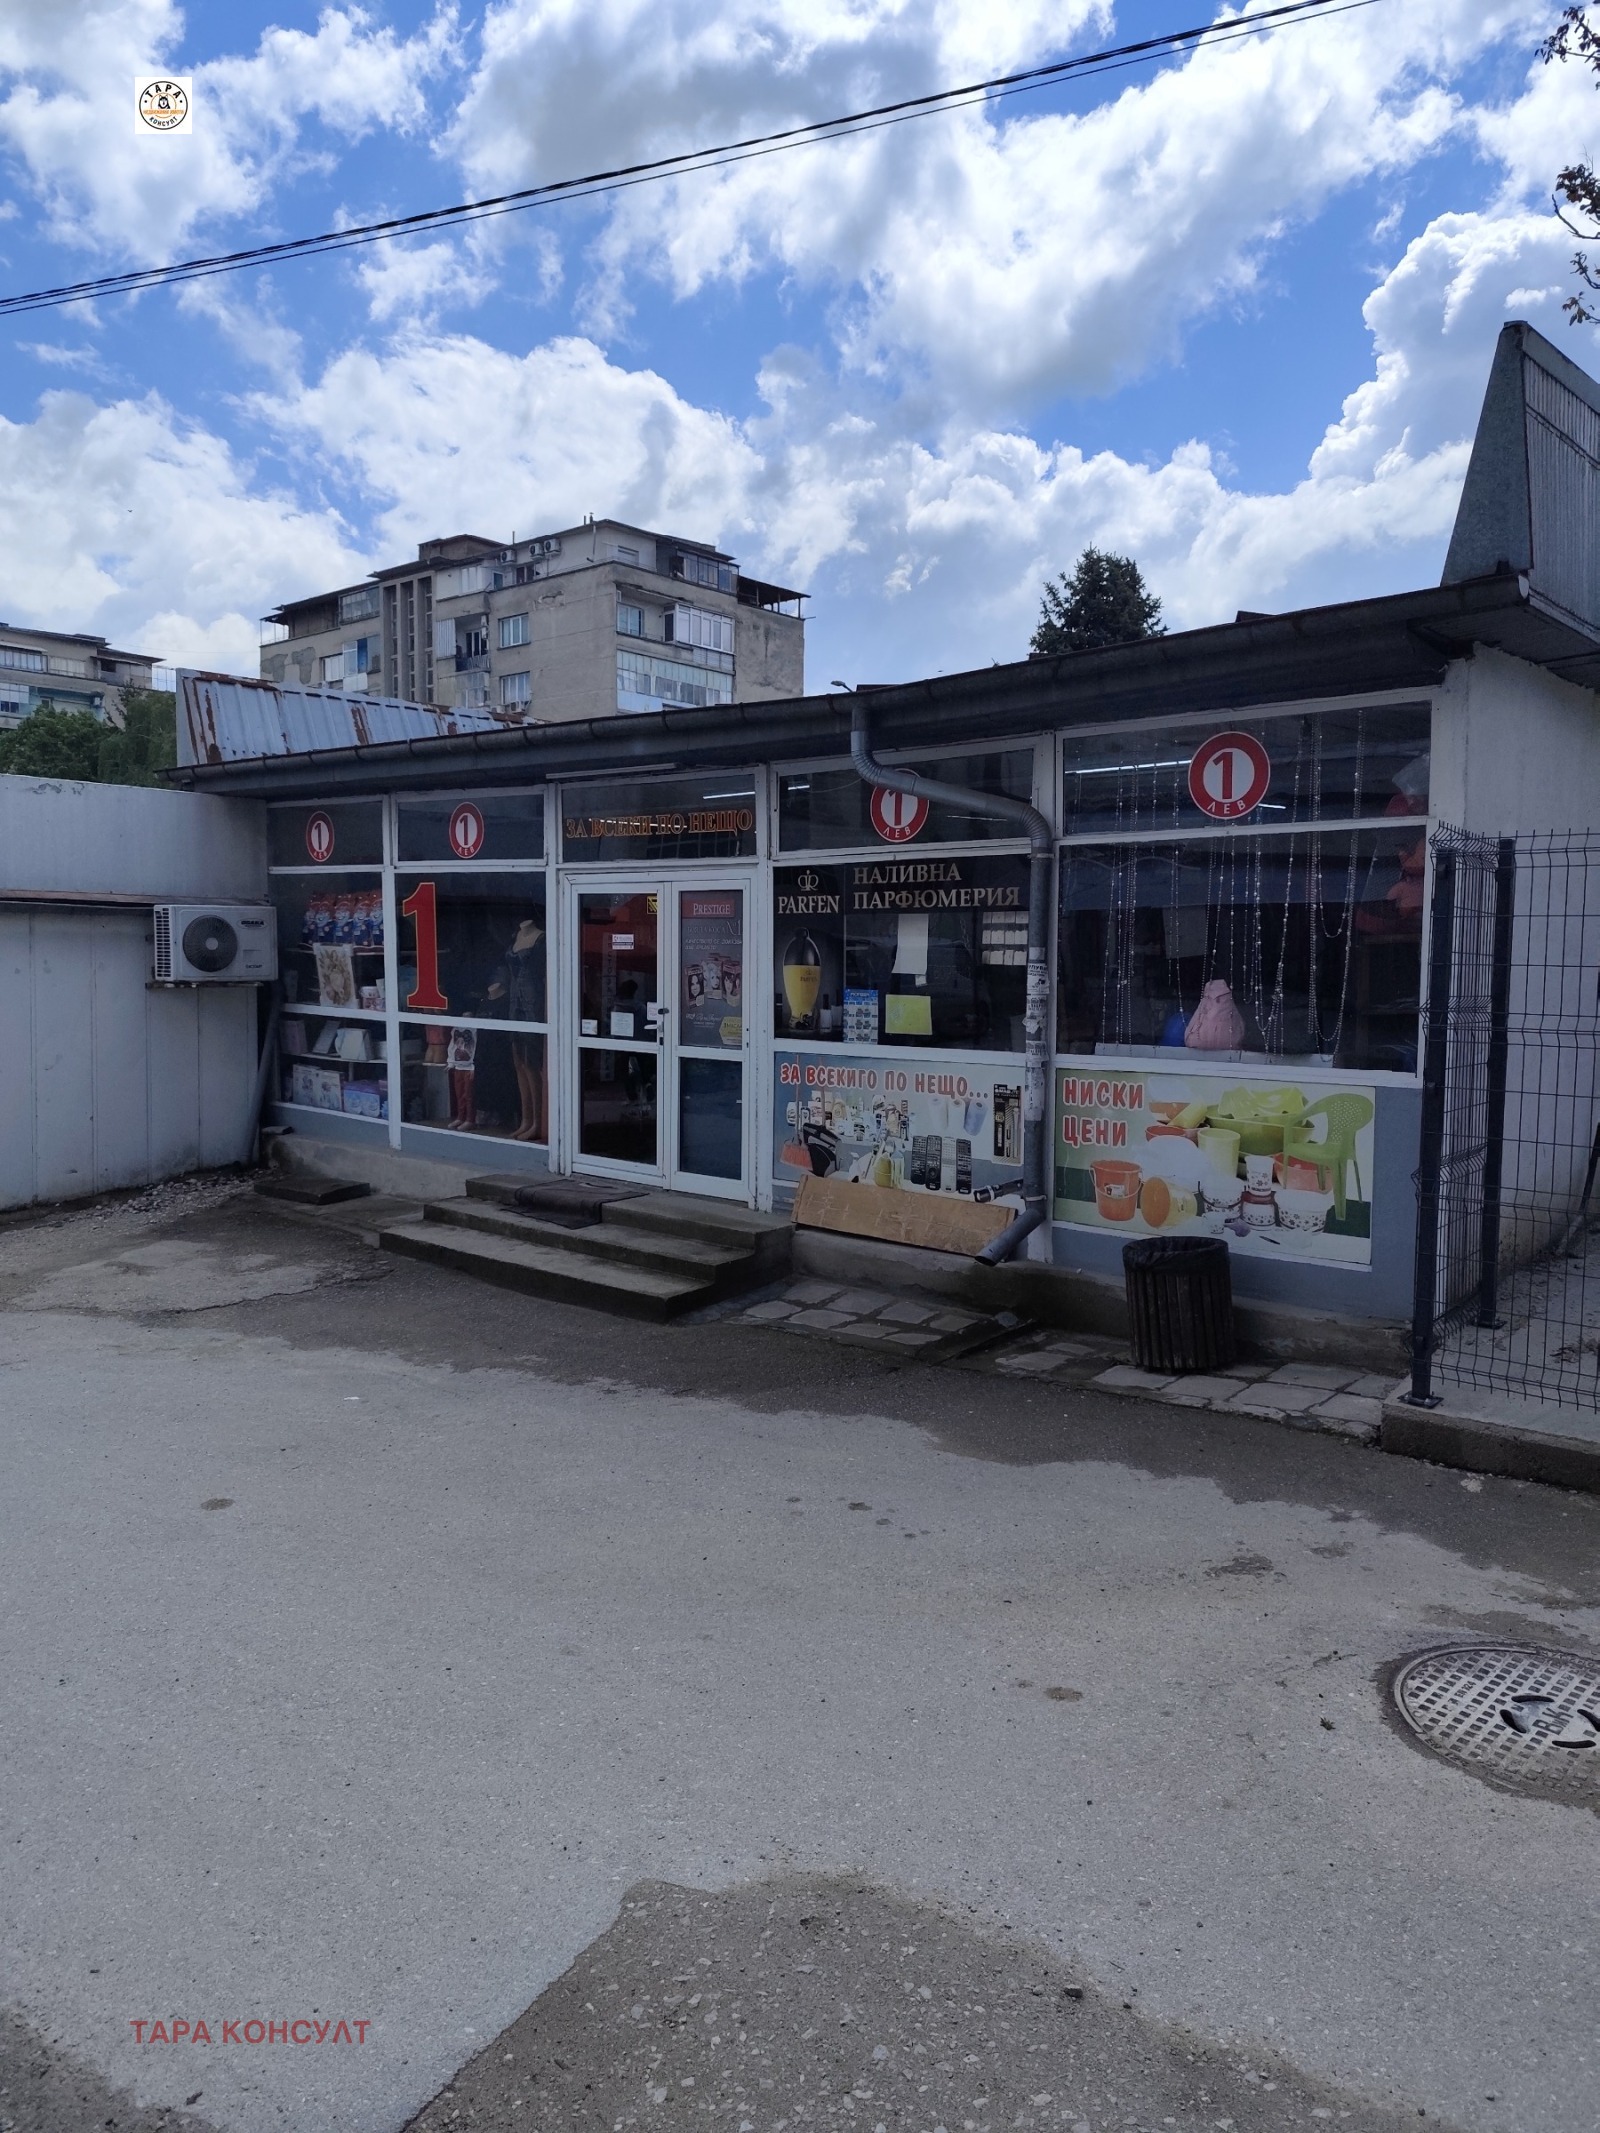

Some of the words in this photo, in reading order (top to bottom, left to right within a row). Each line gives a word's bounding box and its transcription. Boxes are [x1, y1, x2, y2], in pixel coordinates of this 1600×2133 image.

[1212, 751, 1234, 800] 1
[888, 788, 904, 826] 1
[1207, 799, 1247, 816] ЛЕВ
[314, 822, 322, 851] 1
[459, 815, 468, 846] 1
[566, 818, 588, 839] ЗА
[591, 815, 652, 838] ВСЕКИ
[655, 813, 685, 835] ПО
[688, 809, 753, 837] НЕЩО
[883, 826, 912, 839] ЛЕВ
[853, 863, 962, 885] НАЛИВНА
[693, 903, 731, 916] PRESTIGE
[778, 895, 840, 914] PARFEN
[853, 887, 1020, 910] ПАРФЮМЕРИЯ
[402, 881, 448, 1010] 1
[781, 1064, 800, 1085] ЗА
[806, 1066, 878, 1090] ВСЕКИГО
[885, 1071, 907, 1092] ПО
[1063, 1077, 1144, 1109] НИСКИ
[1063, 1115, 1128, 1147] ЦЕНИ
